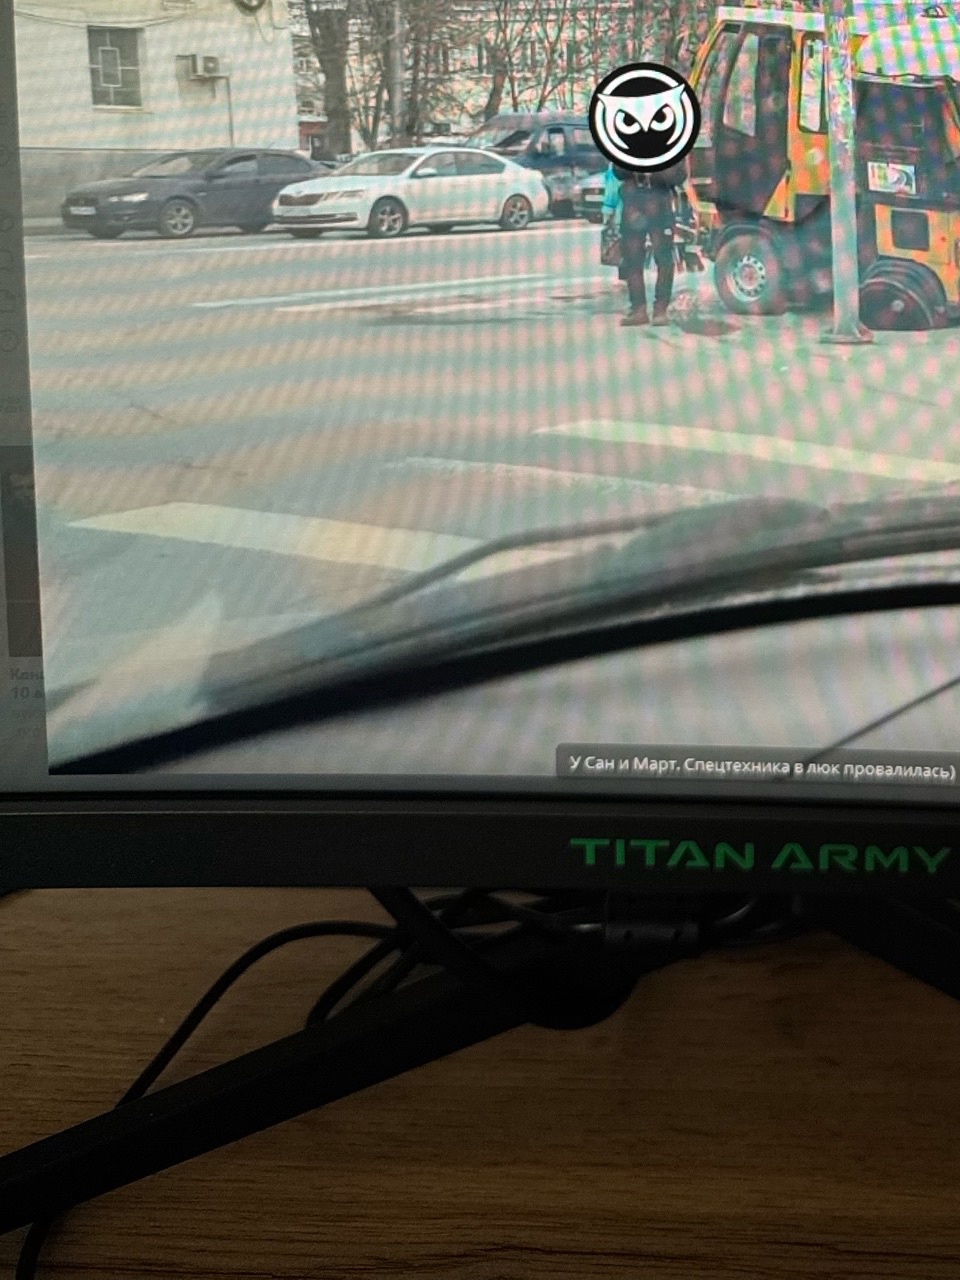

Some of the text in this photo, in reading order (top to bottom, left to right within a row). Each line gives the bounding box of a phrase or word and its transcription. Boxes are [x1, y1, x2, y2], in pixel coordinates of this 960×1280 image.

[569, 755, 956, 780] У Сан и Март. Спецтехника в люк провалилась)
[570, 837, 952, 873] TITAN ARMY
